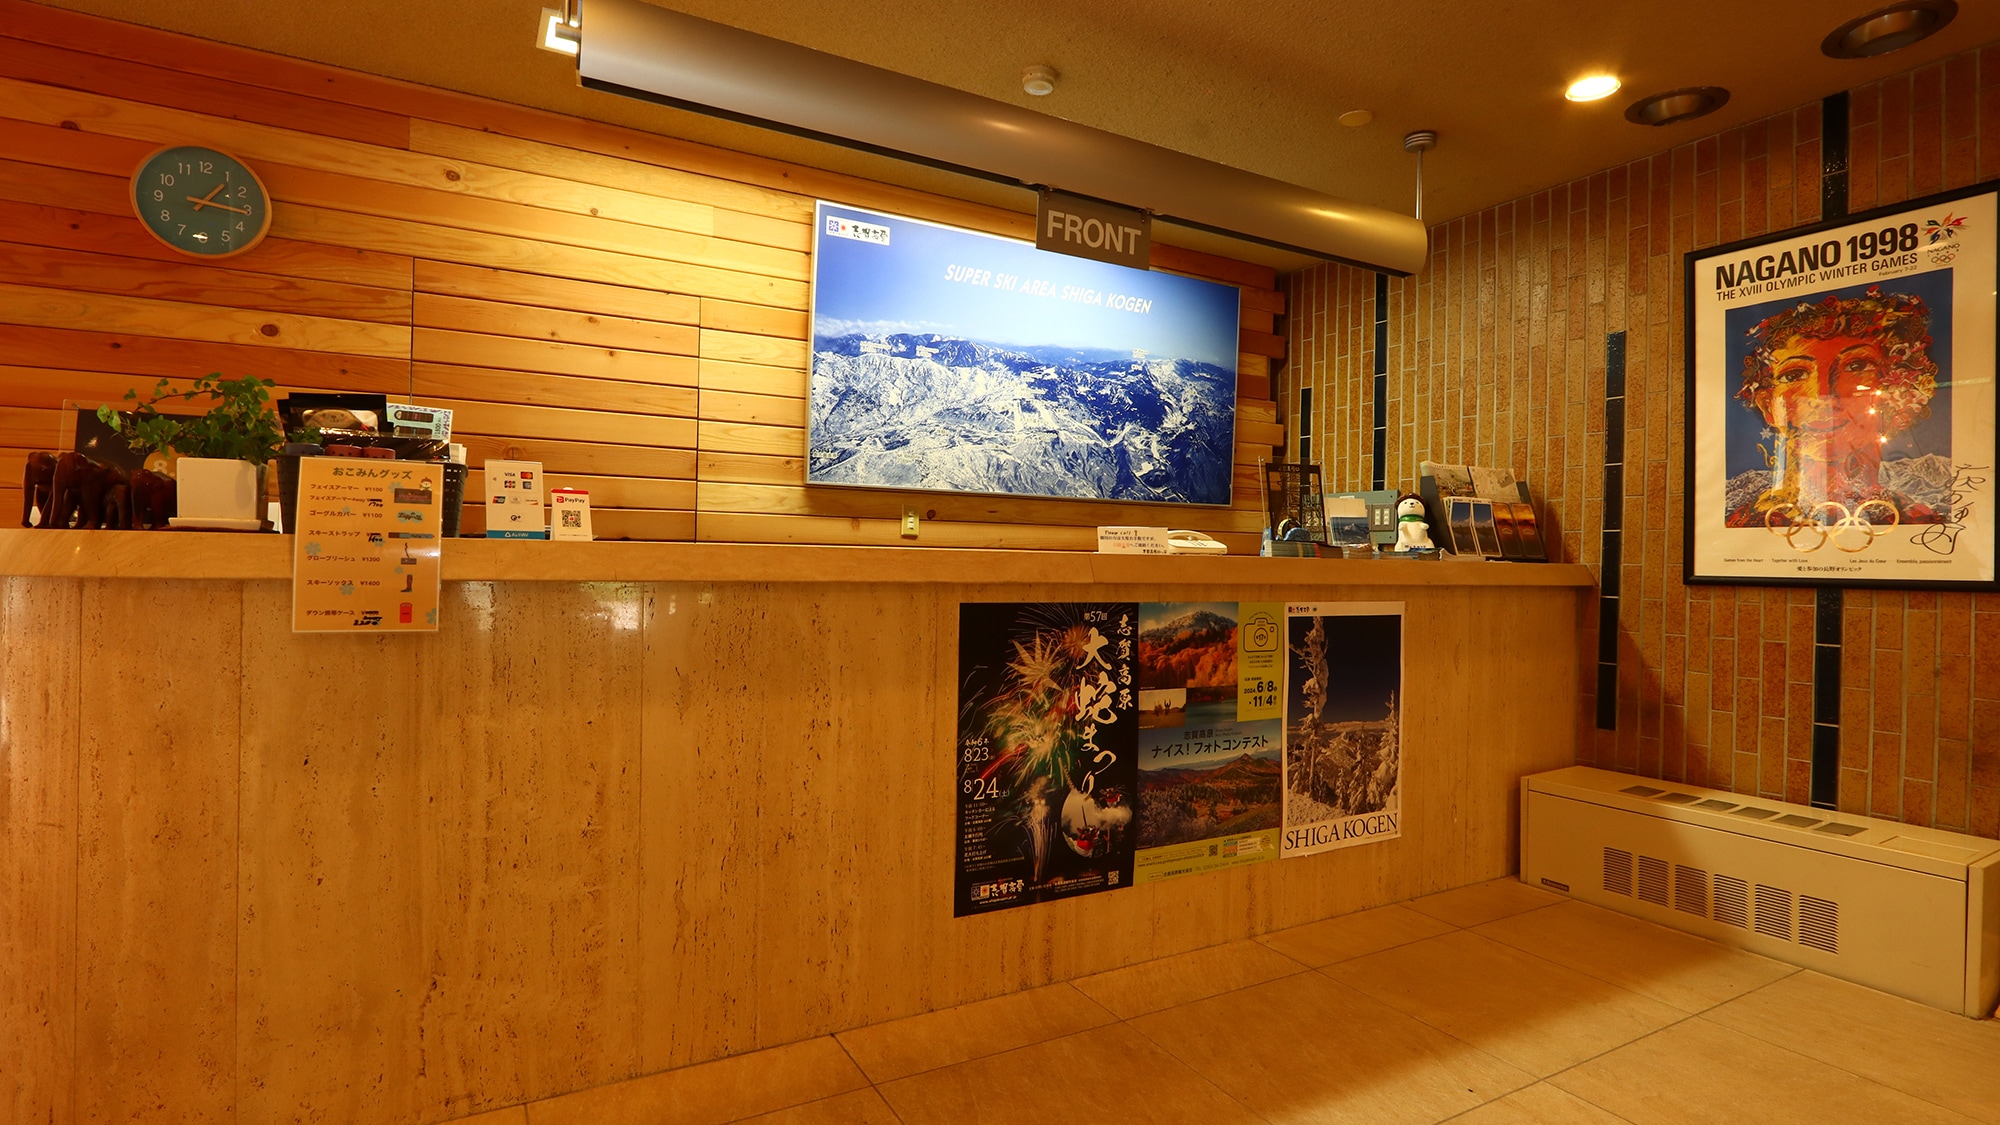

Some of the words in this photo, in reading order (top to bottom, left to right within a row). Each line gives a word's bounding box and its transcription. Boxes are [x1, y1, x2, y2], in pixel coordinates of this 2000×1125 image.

[178, 162, 191, 175] 11
[200, 161, 213, 174] 12
[160, 173, 175, 187] 10
[225, 171, 230, 182] 1
[153, 189, 164, 202] 9
[238, 186, 247, 198] 2
[160, 209, 170, 222] 8
[243, 204, 252, 216] 3
[177, 223, 186, 235] 7
[235, 221, 245, 232] 4
[1047, 209, 1142, 255] FRONT
[220, 230, 231, 242] 5
[1927, 242, 1960, 255] NAGANO
[1716, 240, 1841, 290] NAGANO
[1847, 223, 1919, 262] 1998
[1717, 290, 1736, 302] THE
[1739, 284, 1762, 298] XVIII
[1766, 272, 1816, 292] OLYMPIC
[1819, 263, 1868, 282] WINTER
[1871, 253, 1918, 271] GAMES
[1878, 268, 1903, 278] February
[944, 264, 991, 288] SUPER
[993, 273, 1018, 291] SKI
[1019, 278, 1056, 299] AREA
[1060, 285, 1102, 306] SHIGA
[1105, 292, 1153, 315] KOGEN
[333, 467, 413, 480] おこみんグッズ
[1116, 614, 1133, 710] 志賀高原
[1075, 626, 1118, 799] 大蛇まつり
[1184, 728, 1214, 740] 志賀高原
[1284, 823, 1340, 851] SHIGA
[1343, 813, 1398, 840] KOGEN
